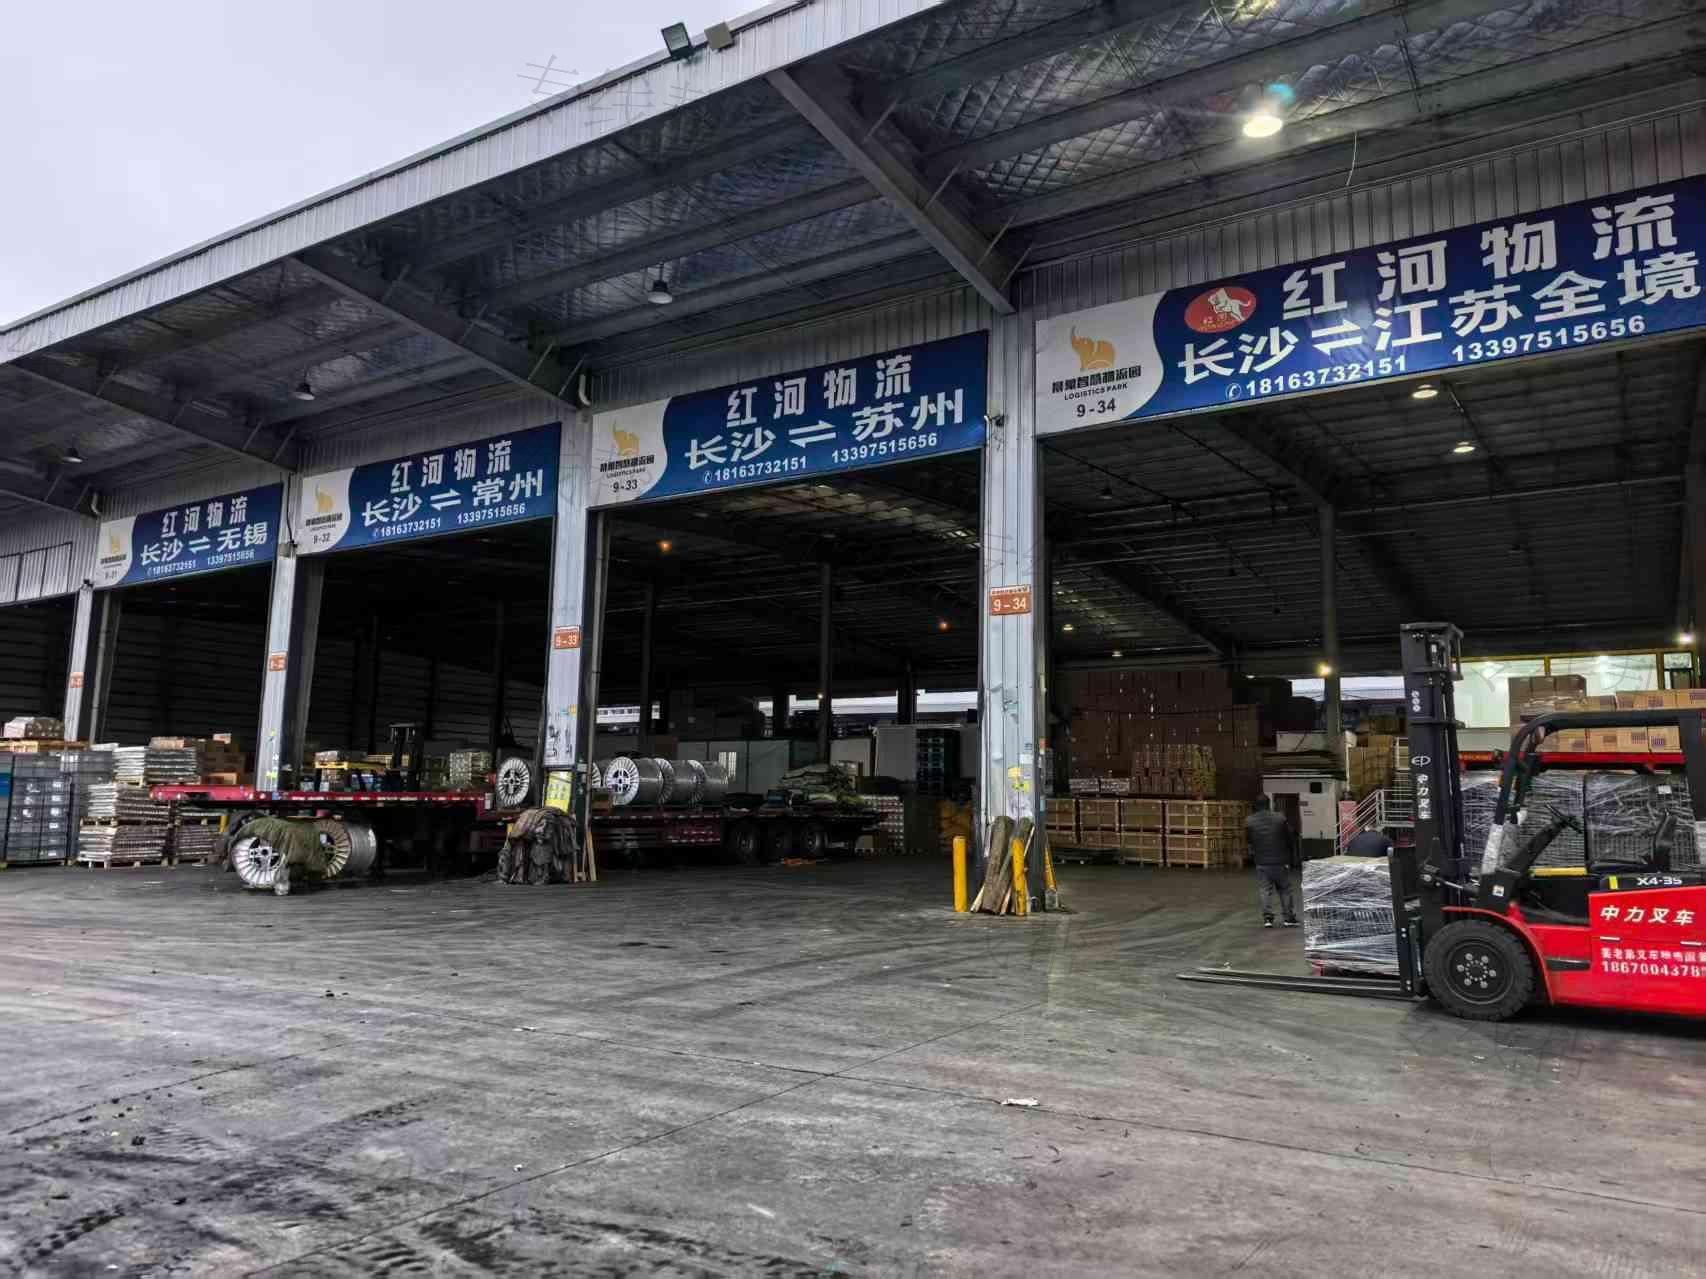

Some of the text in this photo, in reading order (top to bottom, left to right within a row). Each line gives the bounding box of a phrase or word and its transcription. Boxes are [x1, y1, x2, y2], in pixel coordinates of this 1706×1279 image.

[1282, 192, 1678, 319] 红河物流
[1177, 251, 1701, 385] 长沙 江苏全境
[1246, 314, 1645, 396] 18163732151 13397515656
[726, 354, 913, 429] 红河物流
[1064, 382, 1128, 401] LOGISTICS PARK
[1076, 397, 1116, 418] 9-34
[684, 388, 964, 471] 长沙 苏州
[390, 439, 513, 494] 红河物流
[715, 433, 938, 481] 18163732151 13397515656
[362, 469, 543, 527] 长沙 常州
[612, 480, 638, 493] 9-33
[160, 496, 248, 538] 红河物流
[381, 503, 526, 537] 18163732151 13397515656
[141, 521, 268, 566] 长沙 无锡
[993, 597, 1026, 612] 9-34
[1600, 904, 1695, 926] 中力叉车
